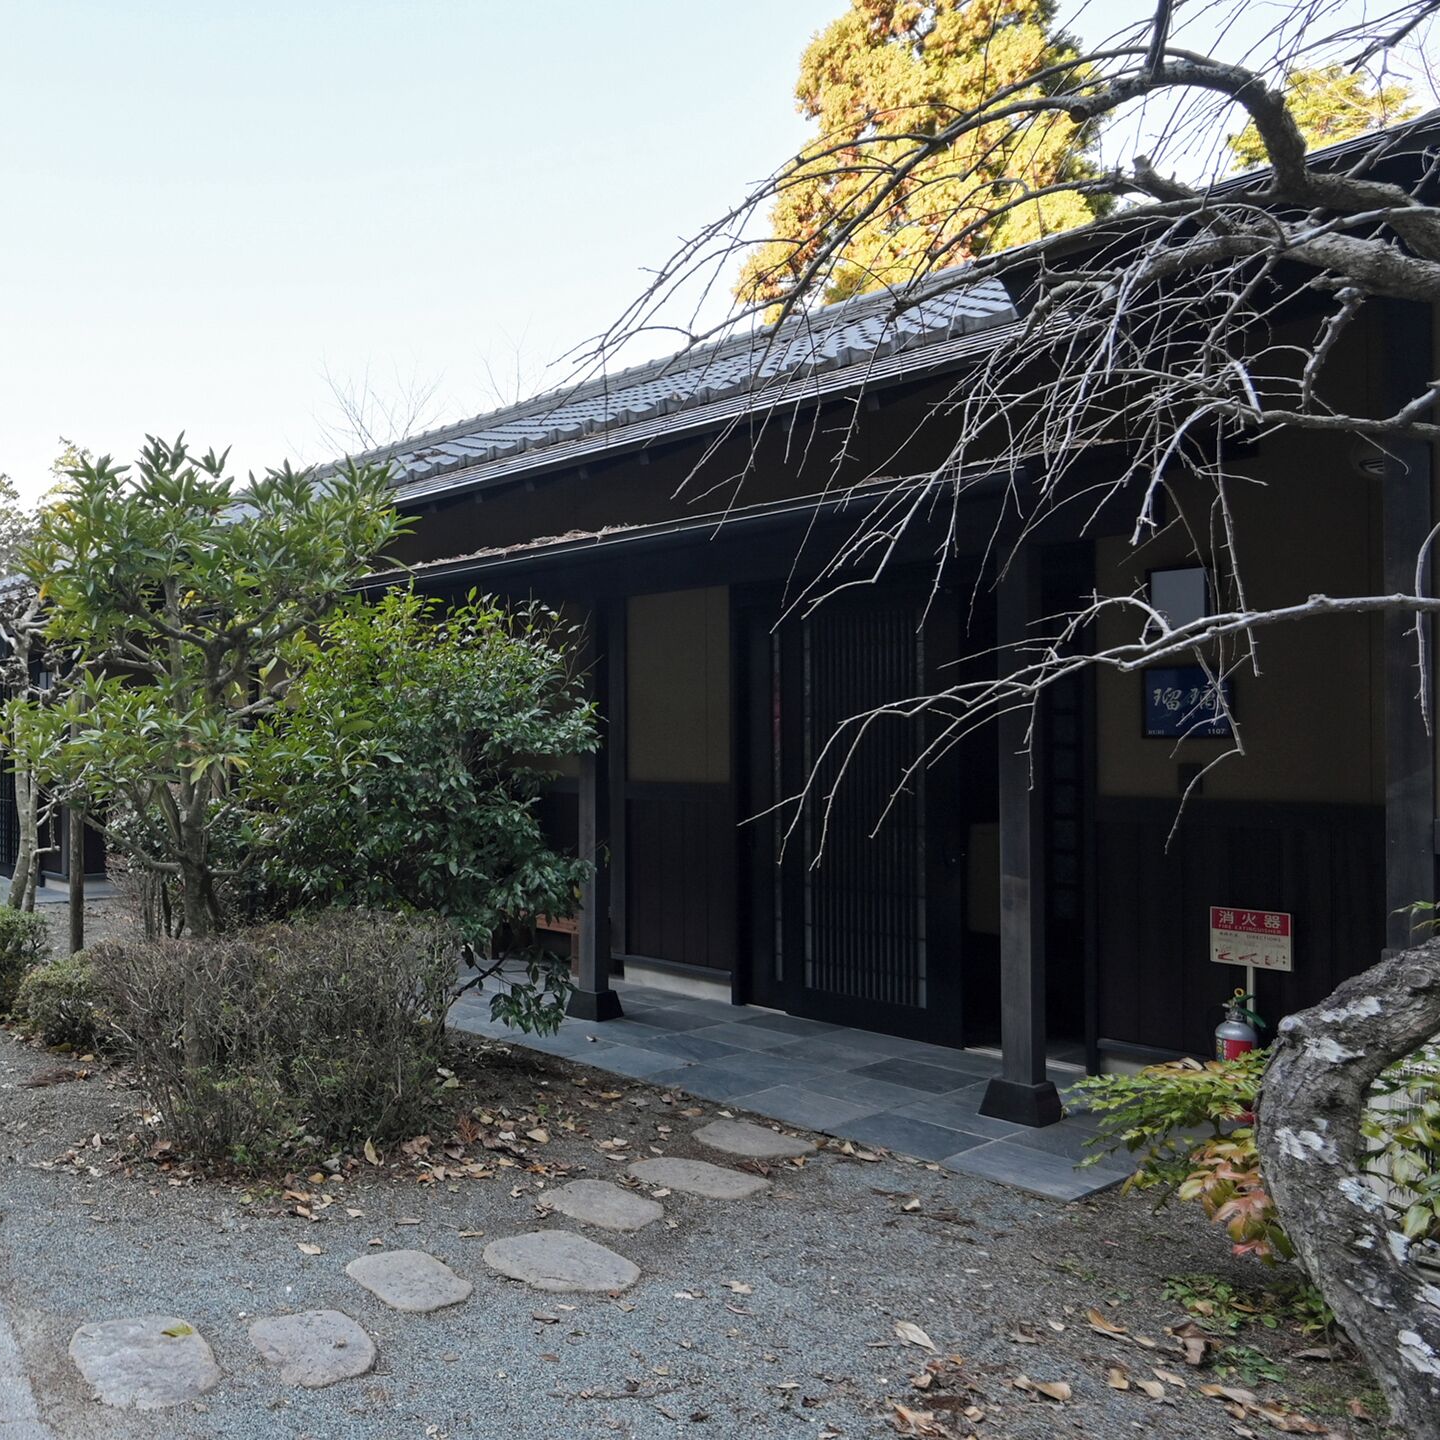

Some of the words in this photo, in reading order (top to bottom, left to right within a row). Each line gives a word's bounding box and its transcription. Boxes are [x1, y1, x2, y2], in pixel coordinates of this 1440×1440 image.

[1219, 911, 1280, 929] 消火器
[1235, 925, 1281, 934] EXTINGUISHER
